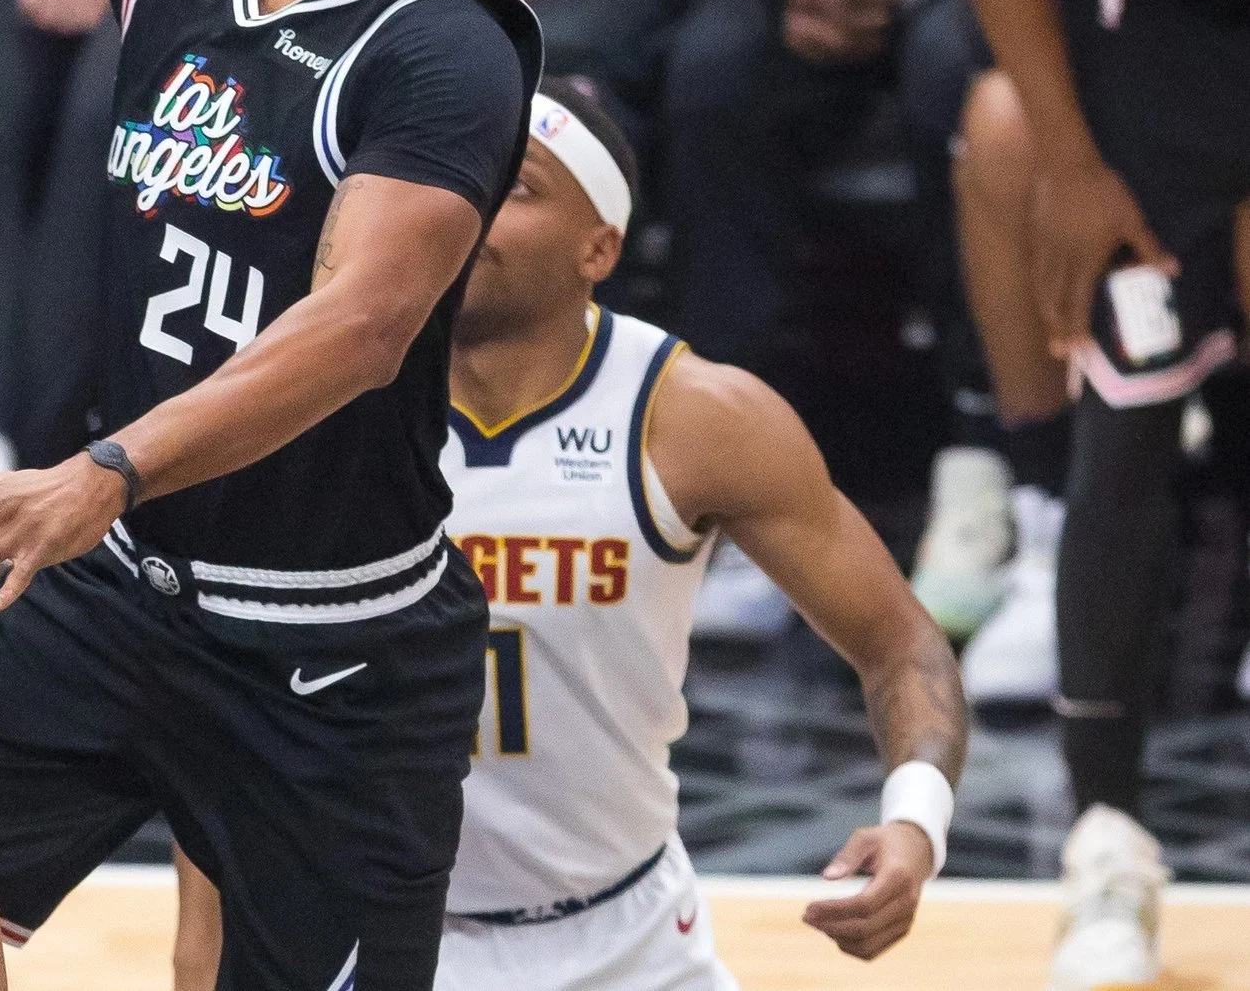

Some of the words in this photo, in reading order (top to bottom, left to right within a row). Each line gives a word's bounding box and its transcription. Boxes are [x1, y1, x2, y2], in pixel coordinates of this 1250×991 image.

[273, 28, 334, 80] honey
[153, 62, 241, 139] los
[107, 125, 284, 211] angeles
[139, 223, 264, 365] 24
[556, 427, 612, 454] WU
[453, 534, 630, 606] GETS
